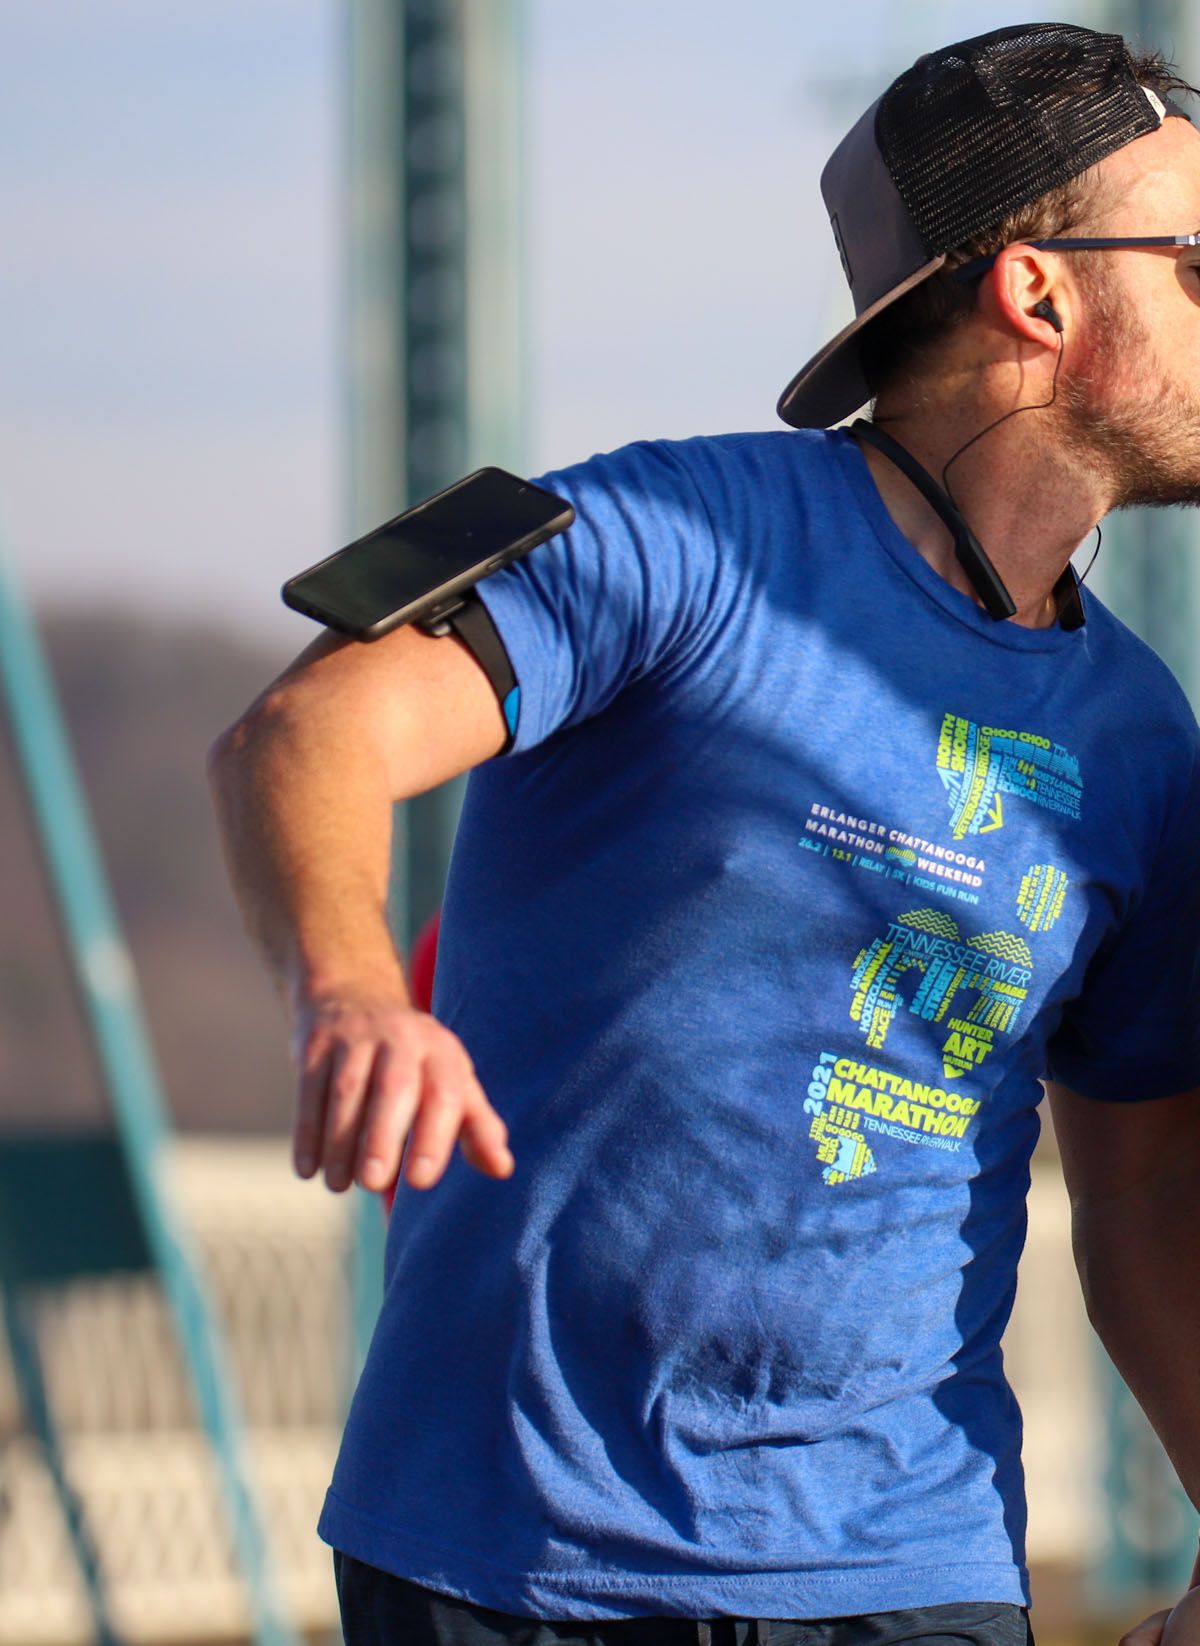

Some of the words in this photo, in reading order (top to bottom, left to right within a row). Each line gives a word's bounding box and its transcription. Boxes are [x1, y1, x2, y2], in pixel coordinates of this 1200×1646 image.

[936, 713, 955, 769] NORTH
[951, 717, 969, 773] SHORE
[981, 726, 1018, 740] CHOO
[1018, 732, 1051, 750] CHOO
[952, 777, 985, 840] VETERANS
[976, 734, 990, 778] BRIDGE
[968, 754, 1002, 835] SOUTHSIDE
[804, 819, 885, 854] MARATHON
[917, 857, 983, 888] WEEKEND
[810, 803, 886, 836] ERLANGER
[889, 829, 986, 872] CHATTANOOGA
[798, 837, 822, 852] 26.2
[832, 848, 852, 861] 13.1
[859, 857, 886, 873] RELAY
[913, 875, 936, 891] KIDS
[936, 885, 958, 898] FUN
[957, 890, 979, 905] RUN
[1029, 865, 1055, 932] MARATHON
[850, 948, 875, 990] LINDSAY
[872, 938, 884, 950] ST
[850, 991, 866, 1021] 6TH
[858, 942, 894, 993] ANNUAL
[885, 922, 987, 972] TENNESSEE
[984, 958, 1032, 987] RIVER
[859, 963, 891, 1033] HOLTZCLAW
[909, 957, 945, 1015] MARKET
[920, 961, 959, 1021] STREET
[933, 997, 951, 1022] MAIN
[946, 967, 967, 998] STREET
[872, 1008, 891, 1049] PLACE
[942, 1032, 993, 1064] ART
[947, 1017, 994, 1042] HUNTER
[803, 1051, 838, 1117] 2021
[826, 1077, 971, 1138] MARATHON
[833, 1058, 981, 1116] CHATTANOOGA
[816, 1136, 832, 1161] MLK
[824, 1137, 840, 1164] BLVD
[863, 1116, 921, 1145] TENNESSEE
